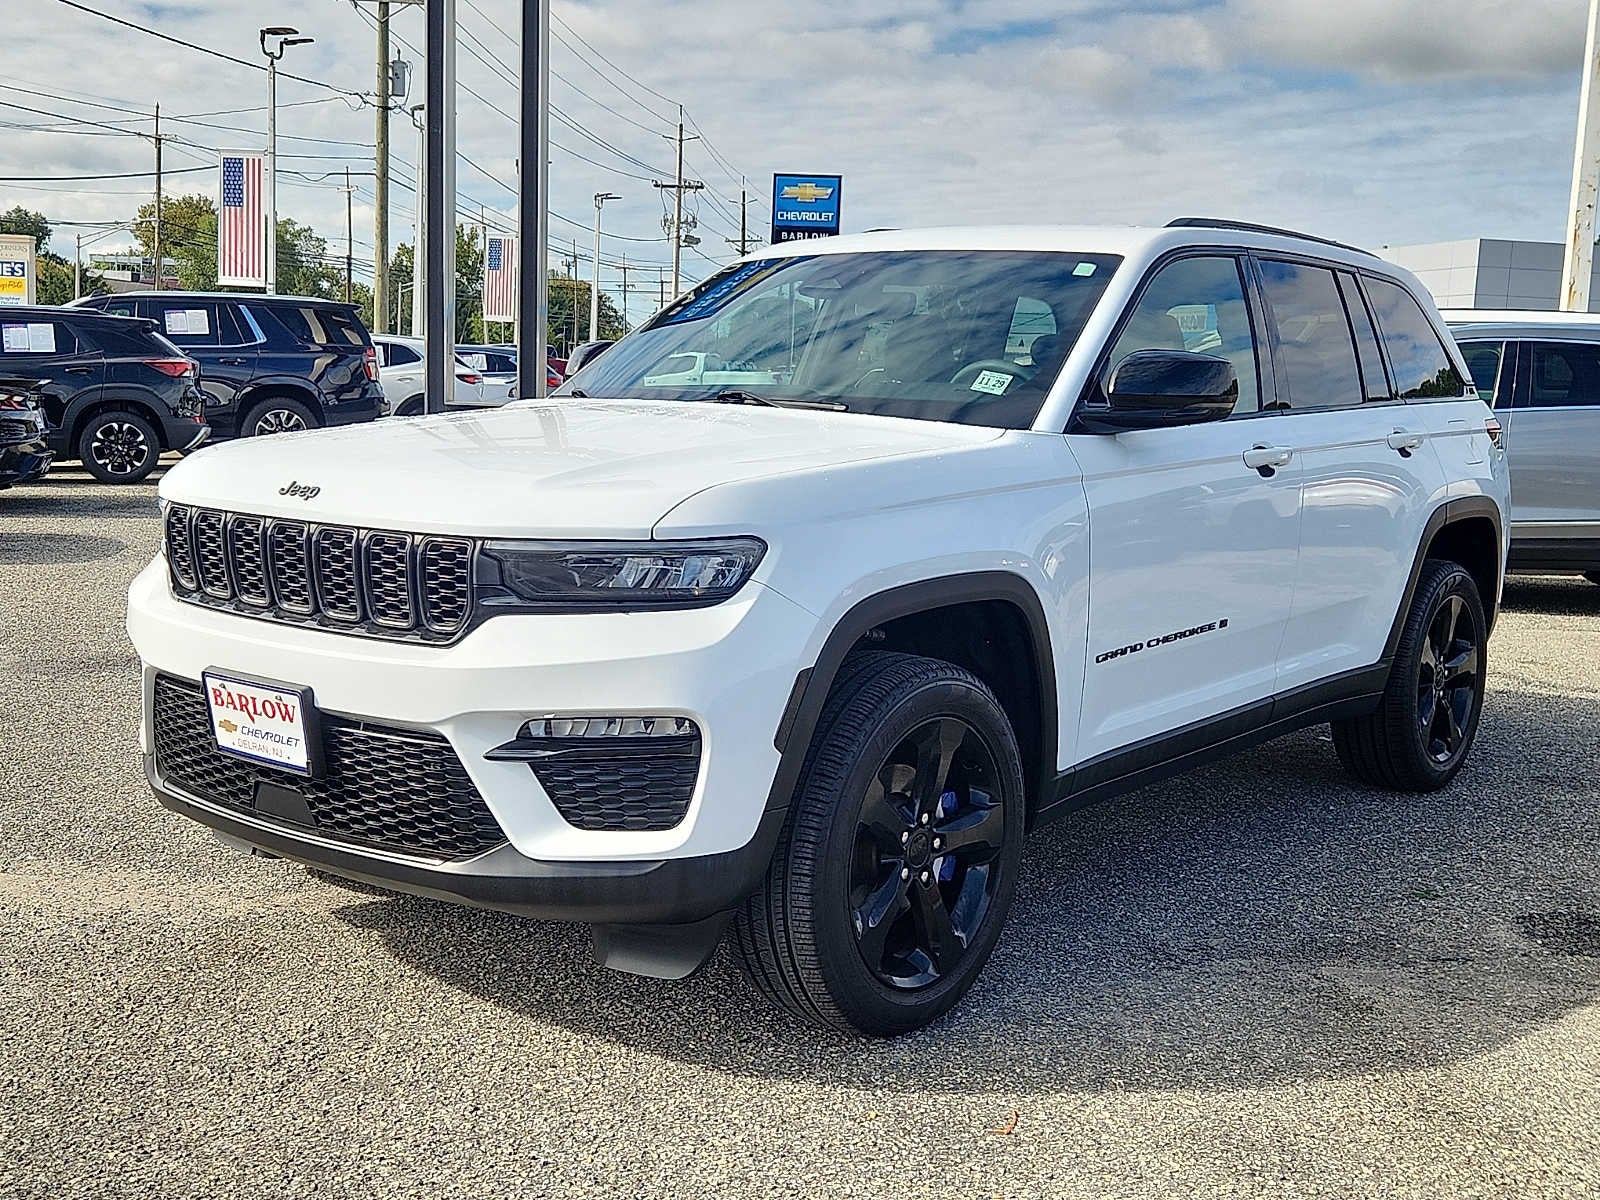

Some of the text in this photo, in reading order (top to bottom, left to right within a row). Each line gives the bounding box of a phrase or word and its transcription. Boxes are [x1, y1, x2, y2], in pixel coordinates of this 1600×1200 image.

[778, 211, 834, 222] CHEVROLET
[781, 231, 830, 240] BARLOW
[0, 262, 24, 277] E'S
[278, 480, 321, 501] Jeep
[1095, 621, 1217, 664] GRAND CHEROKEE
[211, 687, 296, 724] BARLOW
[241, 725, 300, 748] CHEVROLET
